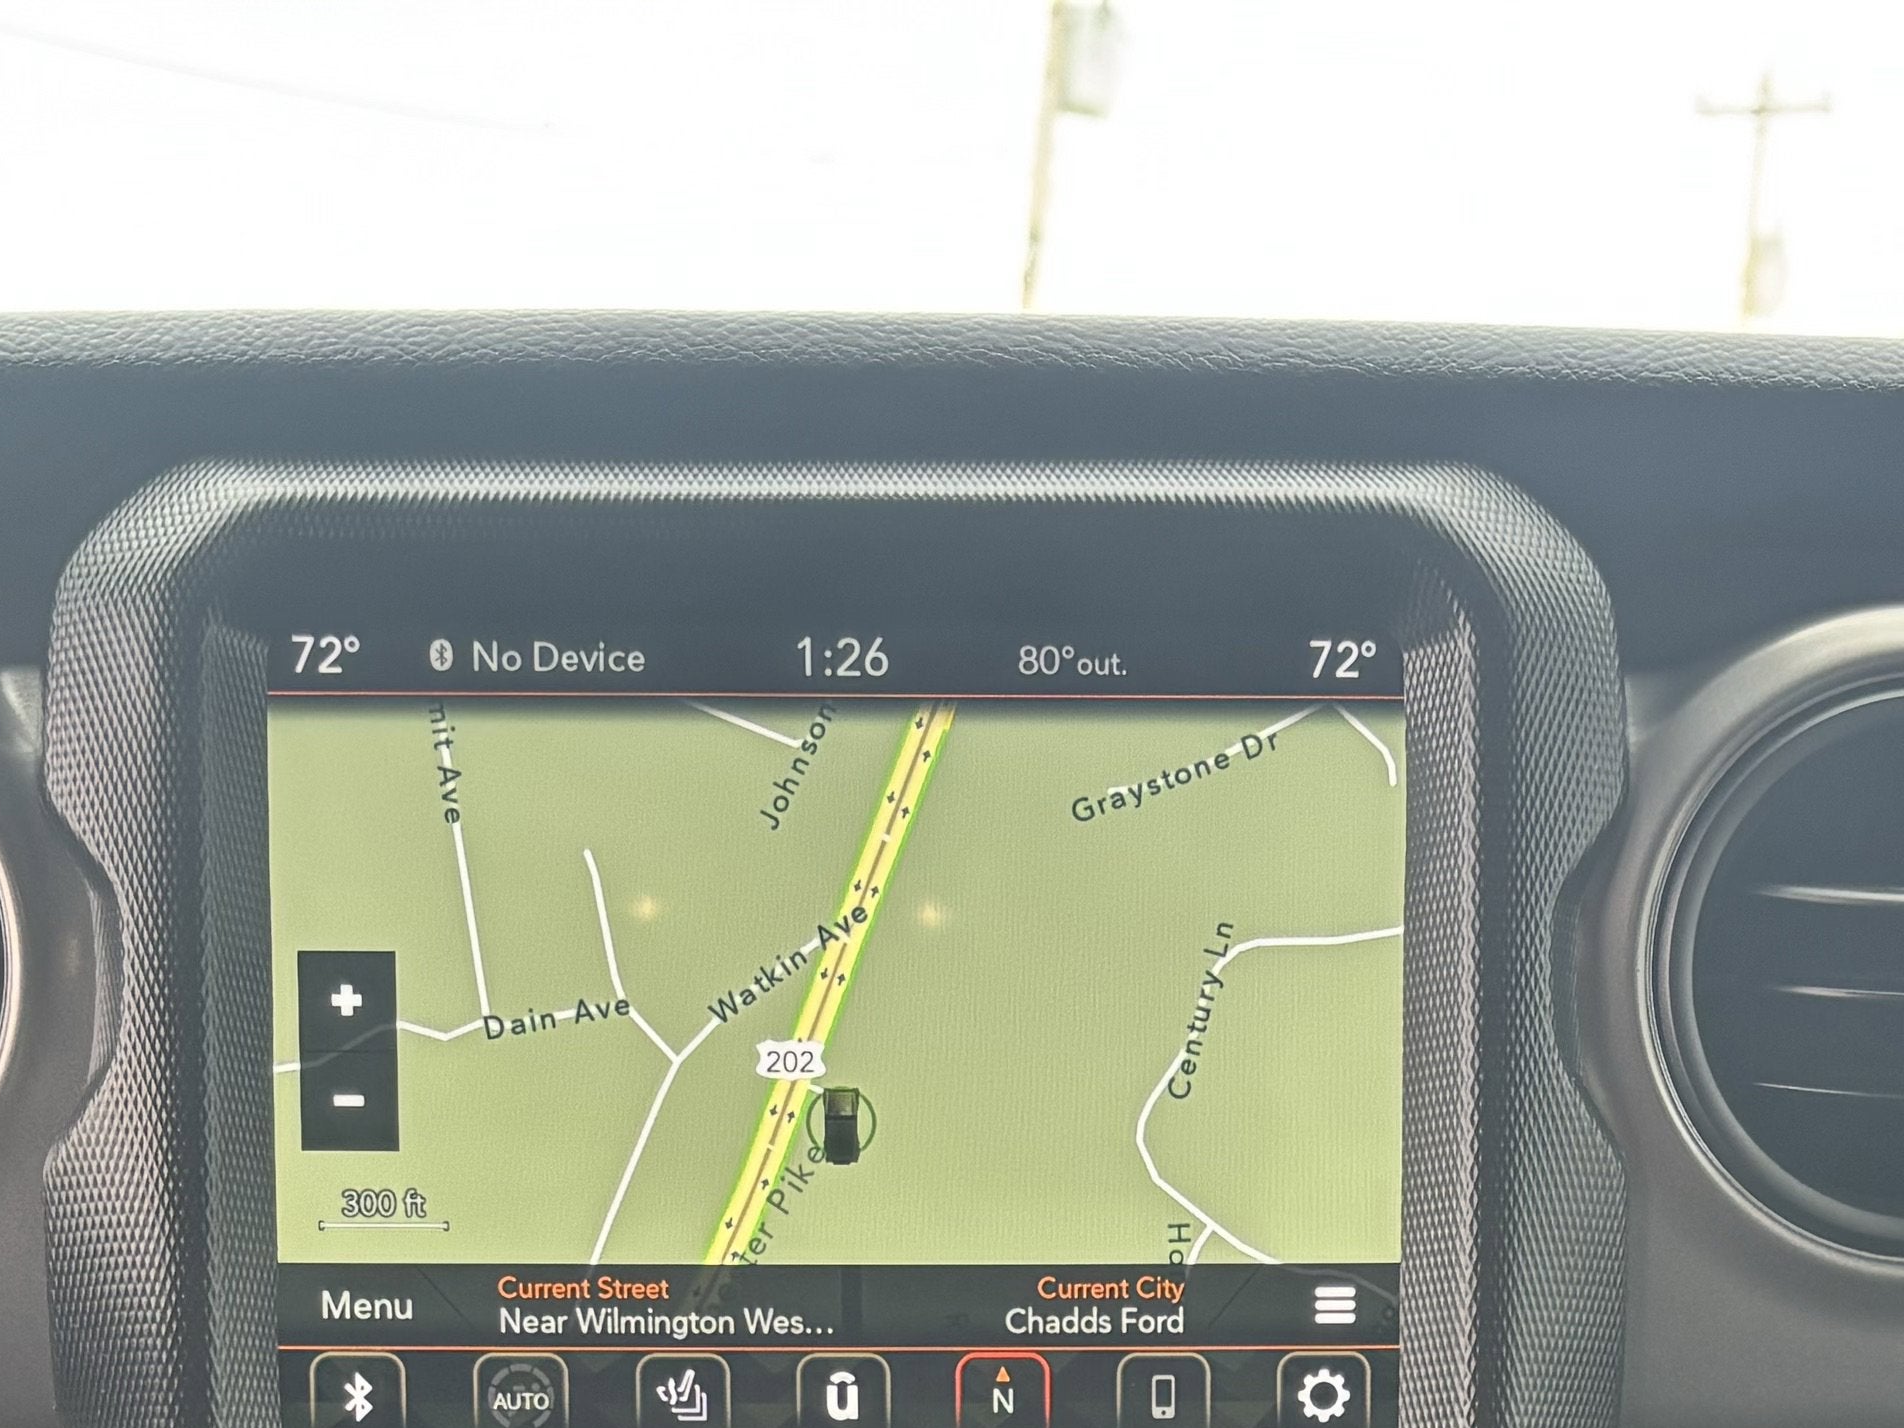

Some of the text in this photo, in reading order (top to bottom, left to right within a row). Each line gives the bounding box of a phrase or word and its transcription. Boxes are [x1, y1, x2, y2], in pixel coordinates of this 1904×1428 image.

[291, 635, 360, 675] 72°
[472, 641, 646, 673] No Device
[796, 636, 889, 678] 1:26
[1309, 640, 1377, 679] 72°
[760, 702, 836, 831] Johnson
[1071, 731, 1279, 823] Graystone Dr
[437, 765, 462, 825] Ave
[707, 903, 869, 1025] Watkin Ave
[484, 998, 631, 1041] Dain Ave
[1168, 921, 1234, 1100] Century Ln
[766, 1051, 815, 1074] 202
[765, 1146, 825, 1216] Pike
[341, 1188, 428, 1219] 300 ft
[321, 1290, 414, 1321] Menu
[497, 1276, 670, 1300] Current Street
[1037, 1275, 1185, 1304] Current City
[499, 1306, 834, 1340] Near Wilmington Wes...
[1004, 1306, 1184, 1335] Chadds Ford
[492, 1391, 551, 1411] AUTO
[992, 1387, 1015, 1414] N
